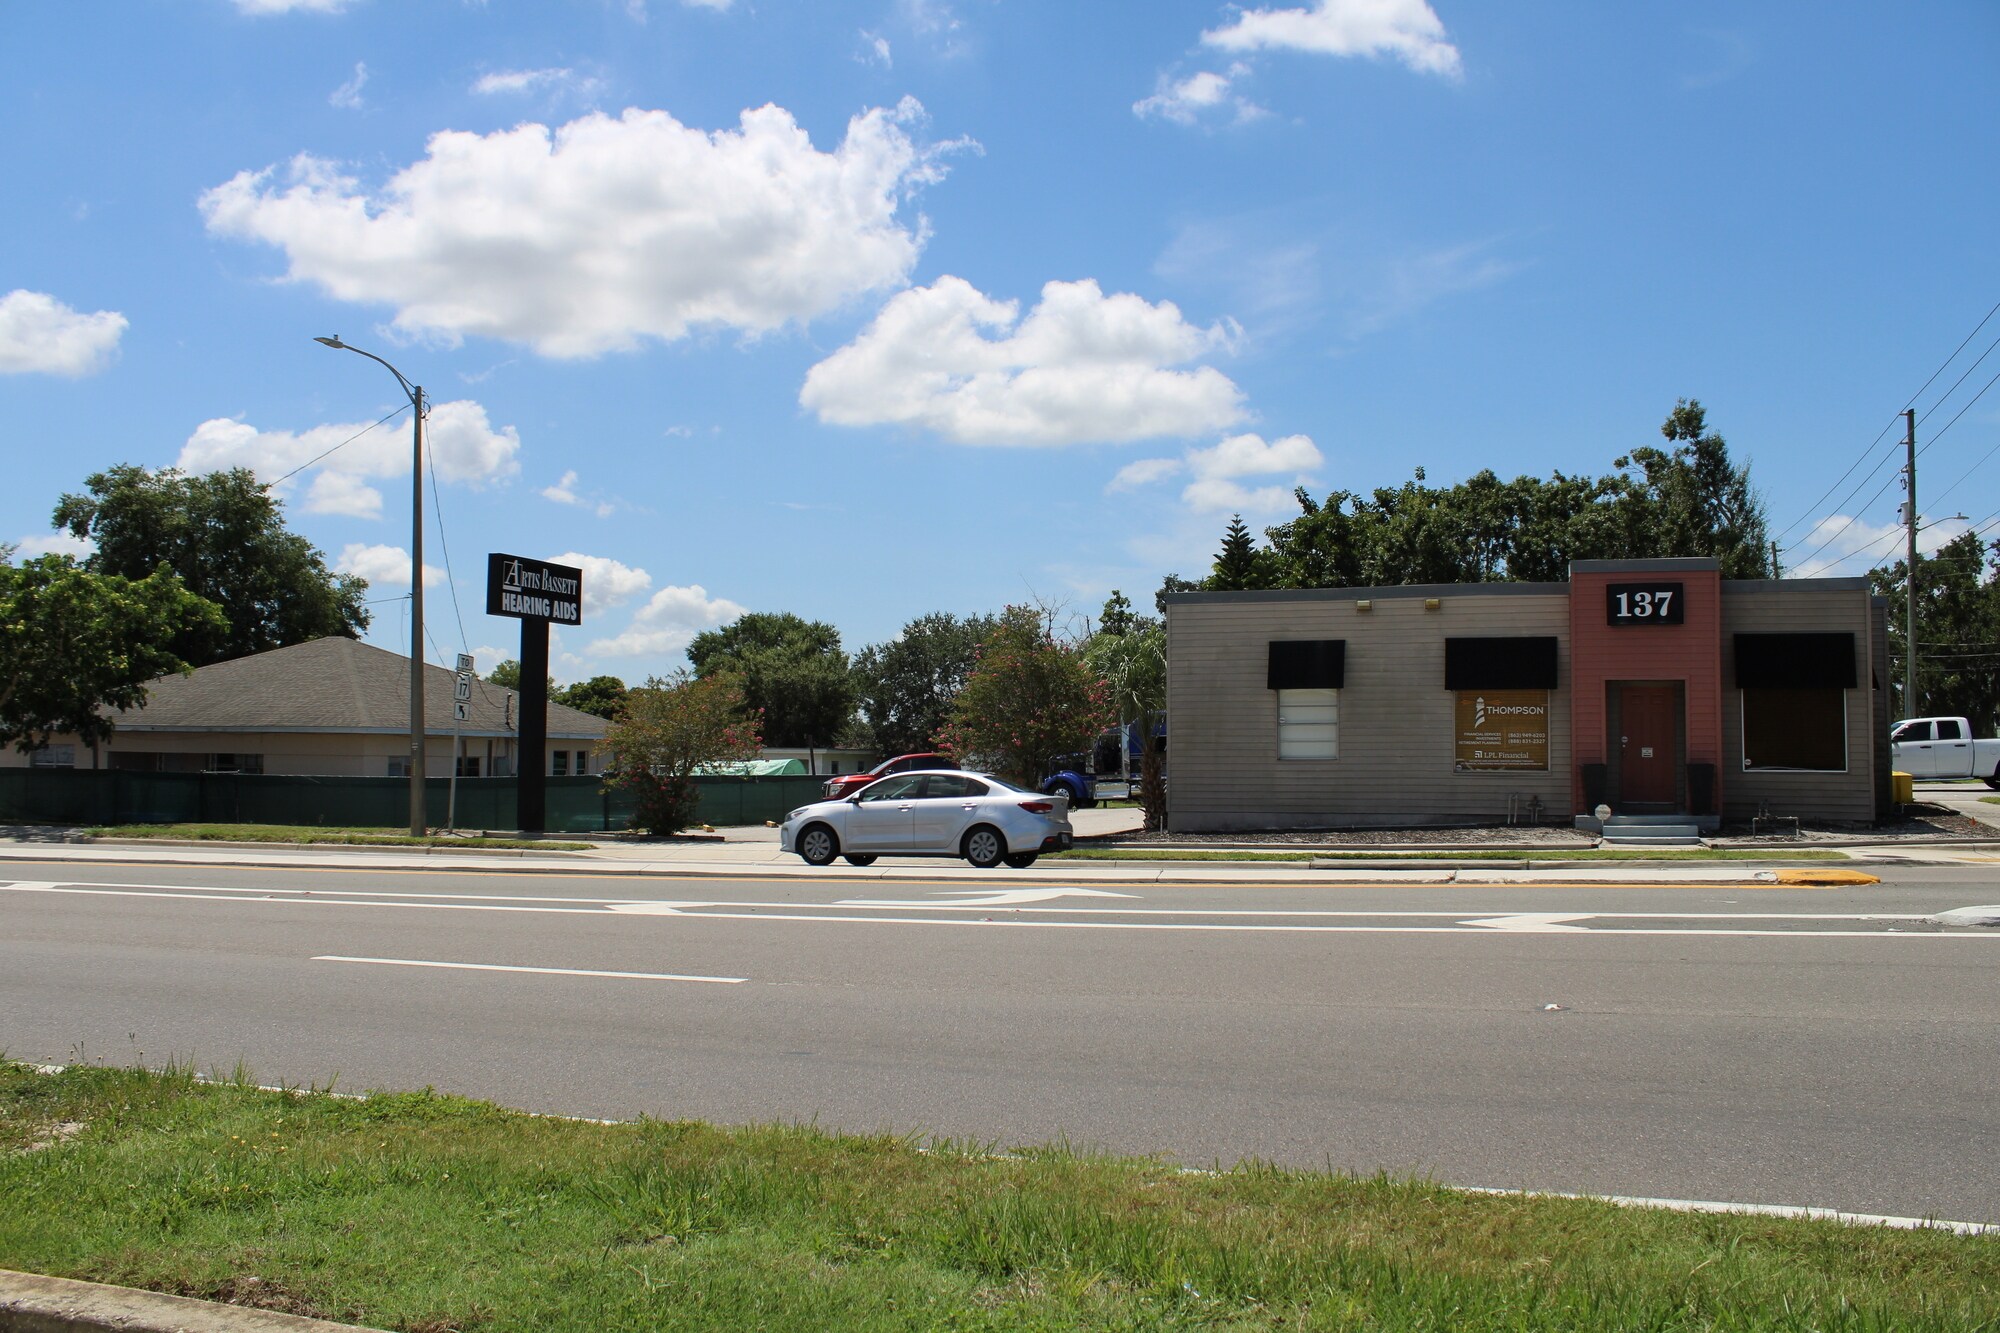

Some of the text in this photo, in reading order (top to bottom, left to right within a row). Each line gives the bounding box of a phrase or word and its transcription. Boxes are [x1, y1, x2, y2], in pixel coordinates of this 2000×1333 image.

[502, 592, 577, 620] HEARING AIDS
[1616, 591, 1673, 617] 137
[461, 657, 470, 667] TO
[459, 682, 468, 697] 17
[1486, 706, 1544, 715] THOMPSON
